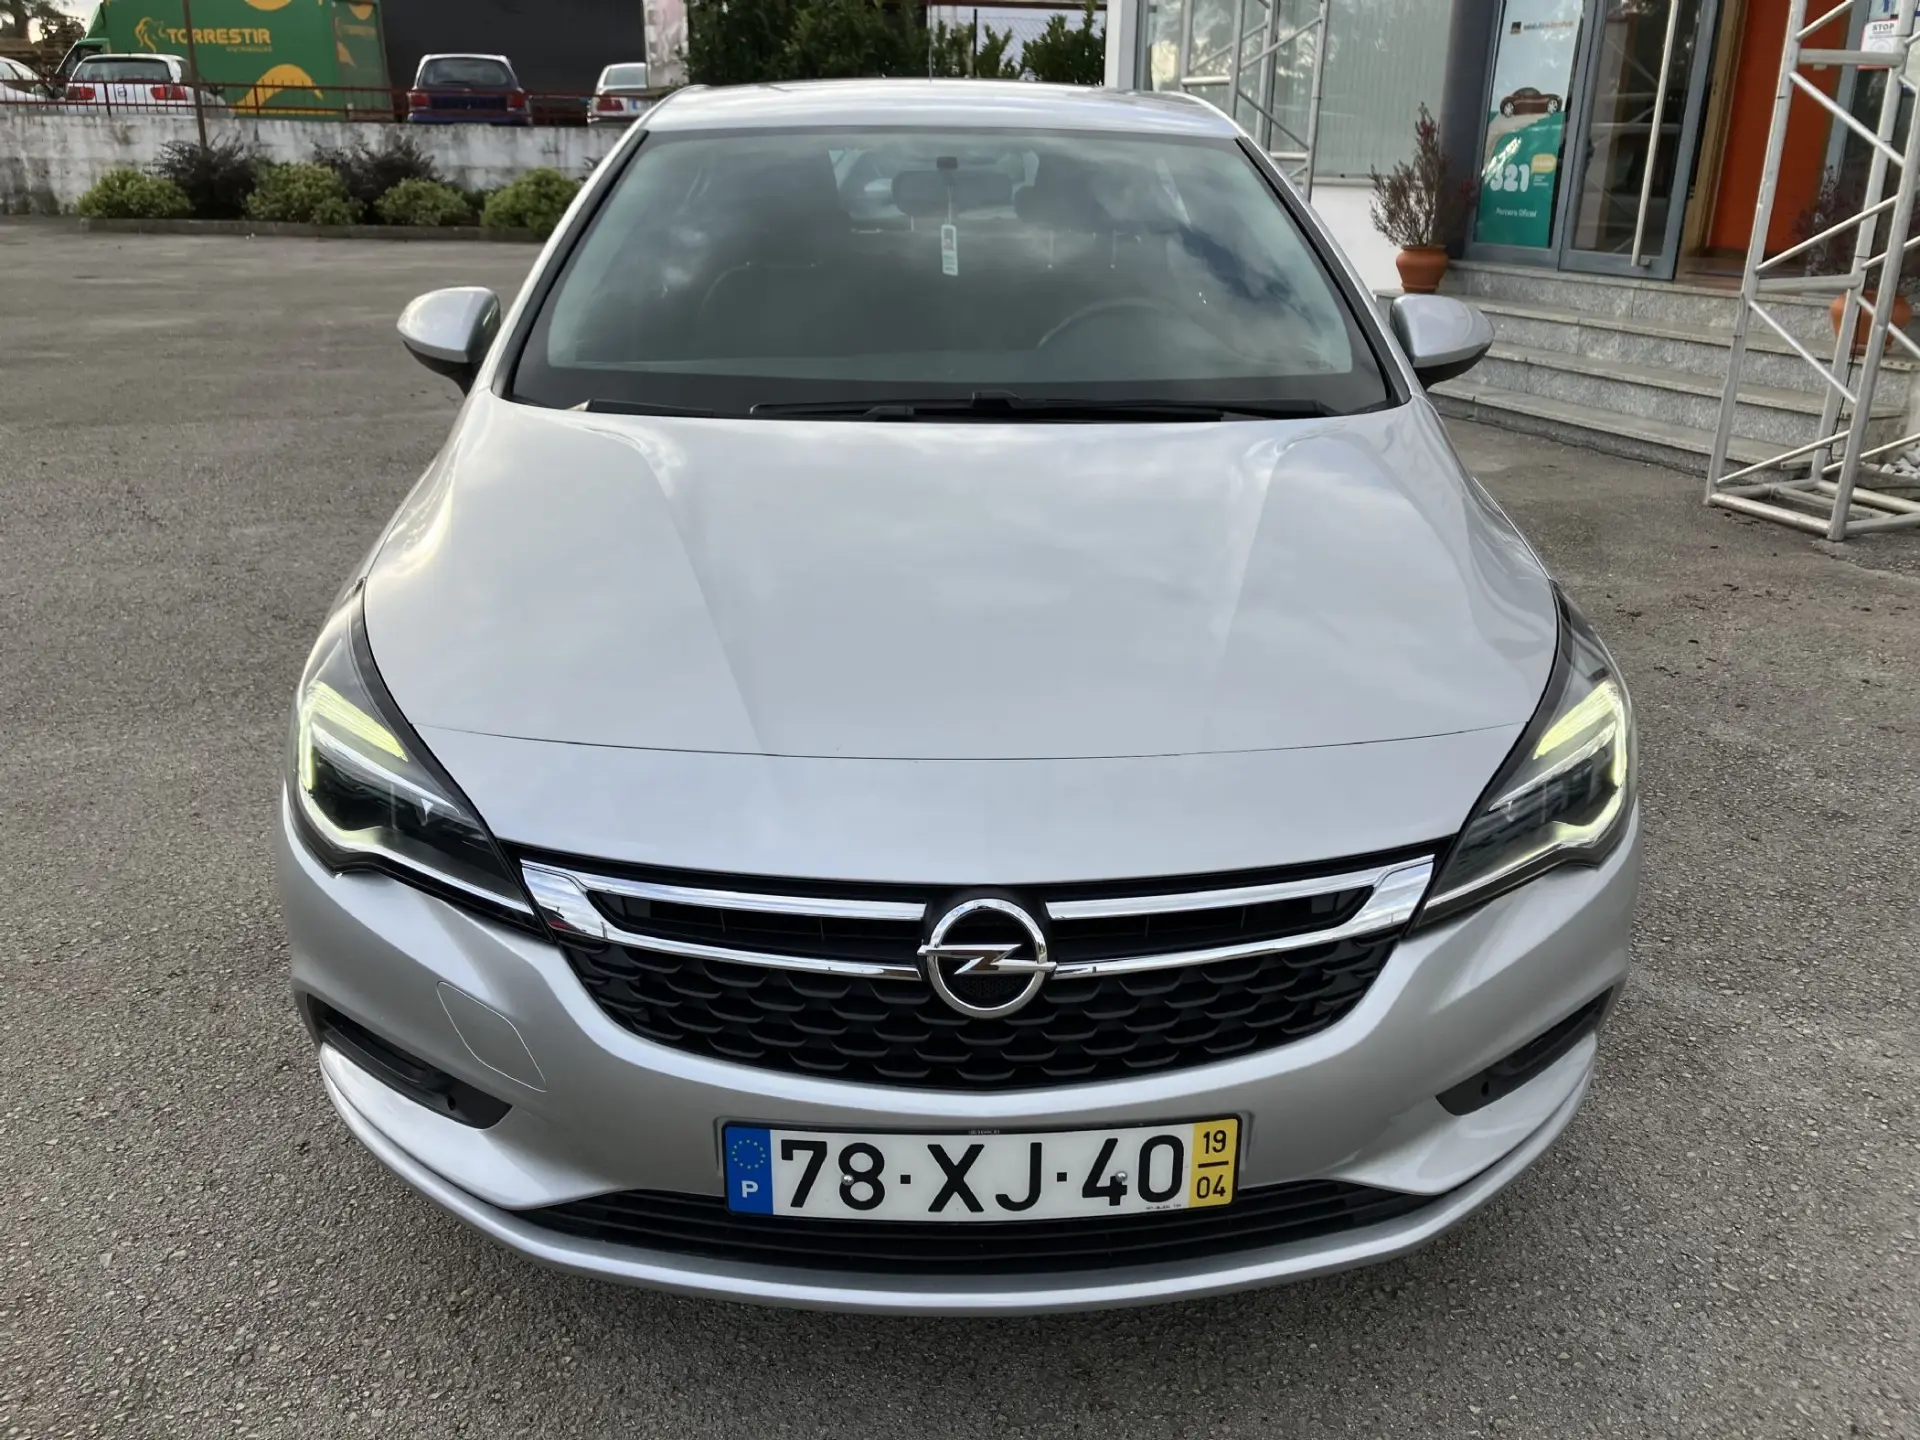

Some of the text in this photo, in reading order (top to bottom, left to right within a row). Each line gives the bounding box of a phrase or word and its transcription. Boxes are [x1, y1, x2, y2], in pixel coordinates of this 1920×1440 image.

[167, 28, 271, 44] TORRESTIR
[1872, 23, 1895, 31] STOP
[1202, 1129, 1227, 1155] 19
[741, 1180, 759, 1198] P
[1196, 1175, 1227, 1200] 04
